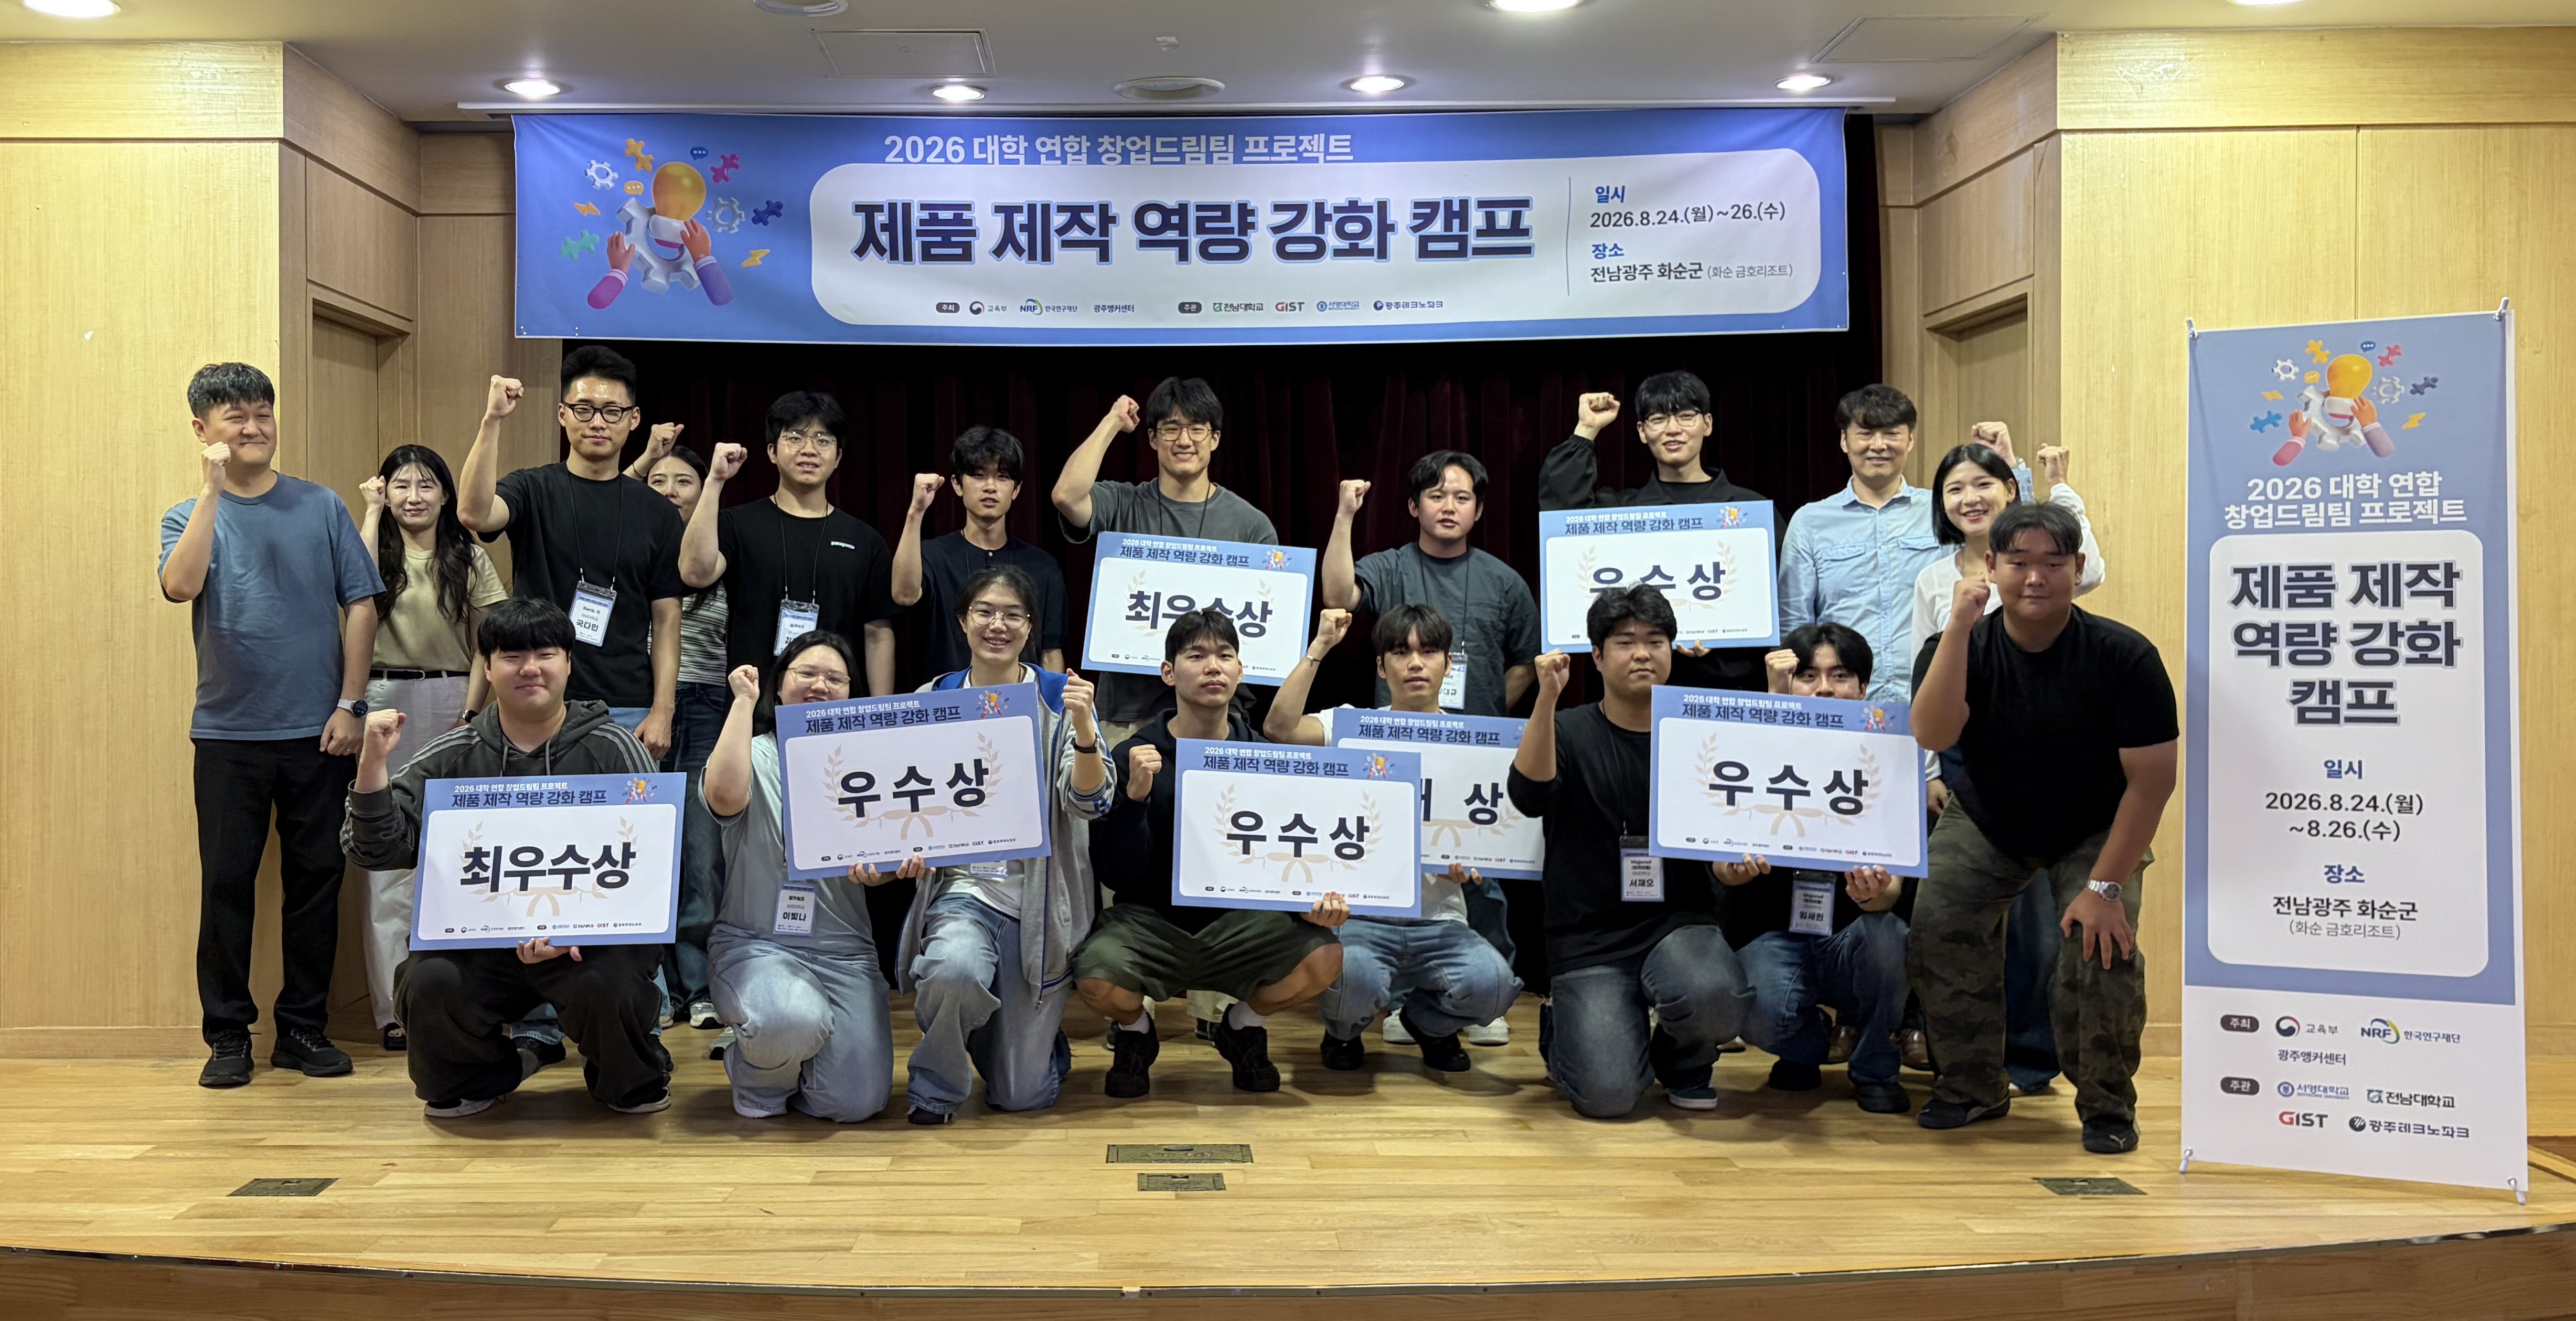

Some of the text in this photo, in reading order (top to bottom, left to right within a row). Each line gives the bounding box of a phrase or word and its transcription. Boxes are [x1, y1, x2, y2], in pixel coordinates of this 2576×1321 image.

[884, 133, 1353, 165] 2026 대학 연합 창업드림팀 프로젝트
[1595, 185, 1626, 204] 일시
[1590, 201, 1786, 228] 2026.8.24.(월)~26.(수)
[852, 196, 1535, 265] 제품 제작 역량 강화 캠프
[1591, 243, 1624, 259] 장소
[1590, 262, 1793, 283] 전남광주 화순군 (화순 금호리조트)
[1094, 304, 1134, 313] 광주앵커센터
[1224, 303, 1264, 312] 전남대학교
[1275, 302, 1305, 312] GIST
[1385, 301, 1443, 310] 광주테크노파크
[2247, 471, 2442, 502] 2026 대학 연합
[2224, 498, 2467, 530] 창업드림팀 프로젝트
[1565, 518, 1703, 535] 제품 제작 역량 강화 캠프
[1120, 546, 1249, 567] 제품 제작 역량 강화 캠프
[2229, 559, 2463, 610] 제품 제작
[2231, 618, 2464, 668] 역량 강화
[1683, 695, 1704, 703] 2026
[2286, 677, 2401, 726] 캠프
[806, 709, 826, 718] 2026
[842, 706, 856, 715] 연합
[893, 700, 920, 710] 프로젝트
[1682, 703, 1844, 728] 제품 제작 역량 강화 캠프
[806, 706, 961, 733] 제품 제작 역량 강화 캠프
[1359, 724, 1500, 745] 제품 제작 역량 강화 캠프
[1203, 755, 1349, 776] 제품 제작 역량 강화 캠프
[2323, 759, 2363, 780] 일시
[452, 790, 606, 808] 제품 제작 역량 강화 캠프
[2264, 792, 2424, 816] 2026.8.24.(월)
[2289, 819, 2401, 842] ~8.26.(수)
[460, 841, 636, 893] 최우수상
[2324, 864, 2365, 884] 장소
[783, 912, 806, 921] 이빛나
[2272, 896, 2419, 921] 전남광주 화순군
[2289, 920, 2401, 940] (화순 금호리조트)
[2229, 1018, 2251, 1029] 주최
[2305, 1023, 2339, 1035] 교육부
[2360, 1027, 2392, 1039] NRF
[2403, 1030, 2462, 1044] 한국연구재단
[2278, 1049, 2347, 1066] 광주앵커센터
[2229, 1080, 2251, 1092] 주관
[2296, 1083, 2349, 1097] 서영대학교
[2386, 1091, 2455, 1109] 전남대학교
[2279, 1111, 2328, 1128] GIST
[2369, 1120, 2470, 1138] 광주테크노파크
